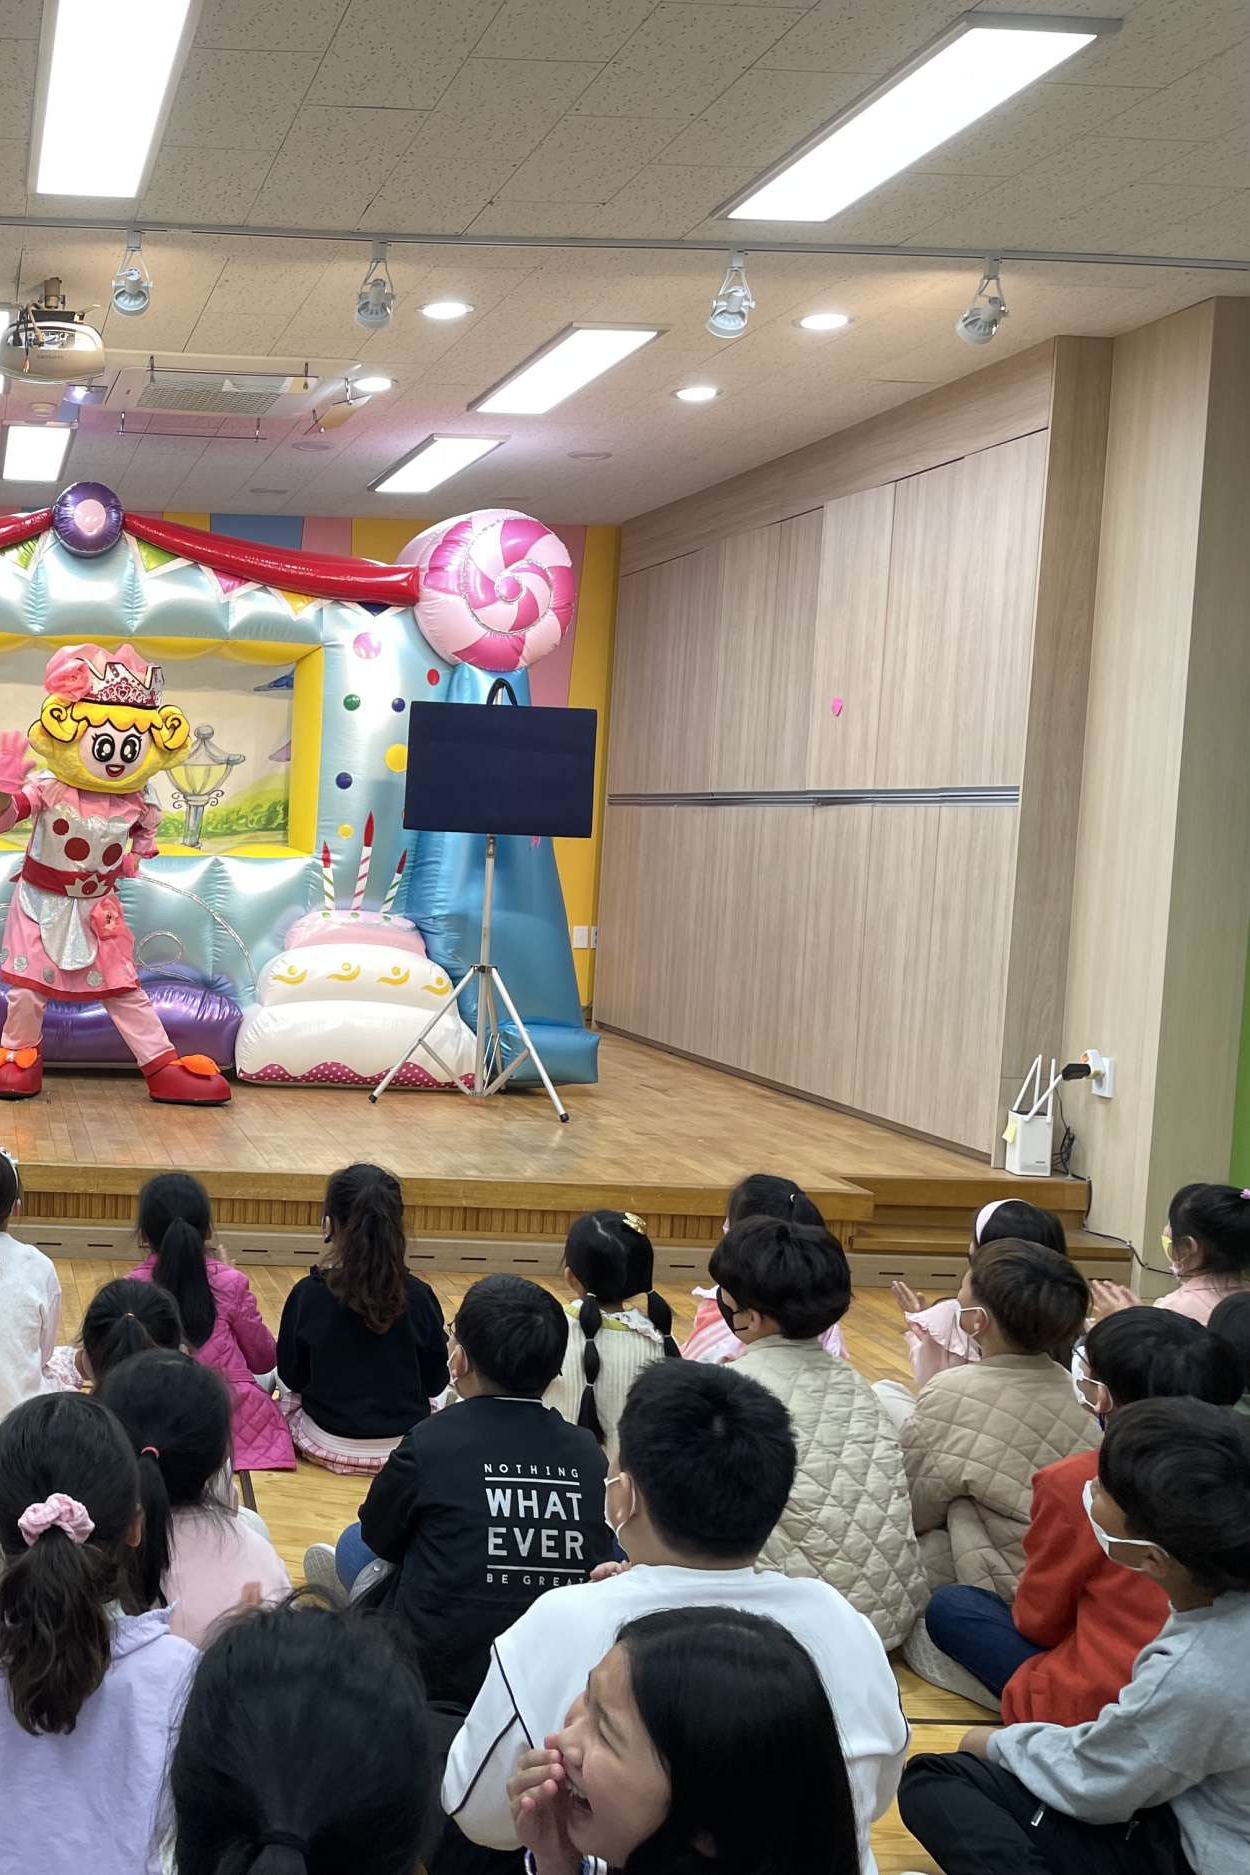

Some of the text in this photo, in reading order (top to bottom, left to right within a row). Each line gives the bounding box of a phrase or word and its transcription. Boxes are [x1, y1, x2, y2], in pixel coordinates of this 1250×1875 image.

[484, 1463, 579, 1478] NOTHING
[485, 1488, 582, 1521] WHAT
[488, 1526, 584, 1560] EVER
[486, 1573, 508, 1584] BE
